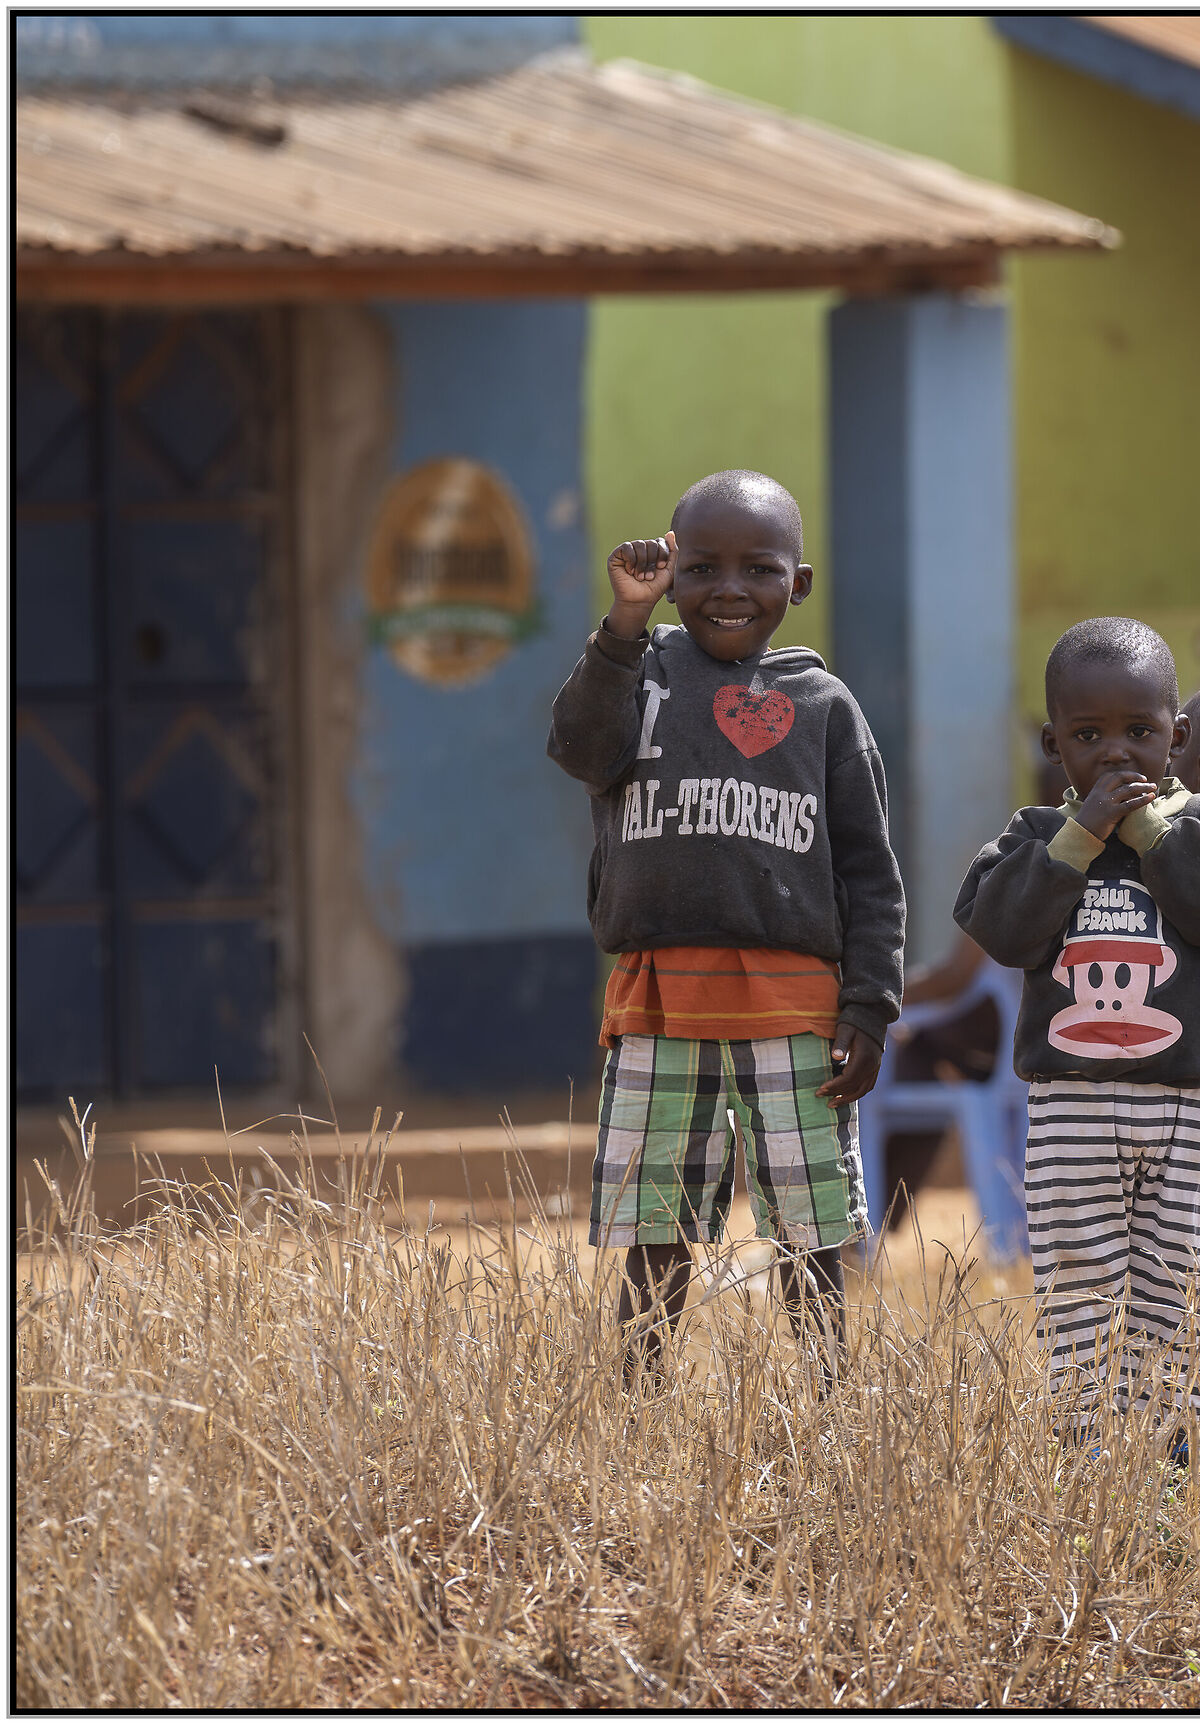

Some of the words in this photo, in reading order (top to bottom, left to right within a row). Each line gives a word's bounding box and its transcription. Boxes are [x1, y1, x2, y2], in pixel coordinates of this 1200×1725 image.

[635, 679, 671, 760] I
[1083, 887, 1135, 910] PAUL
[1077, 908, 1147, 932] FRANK
